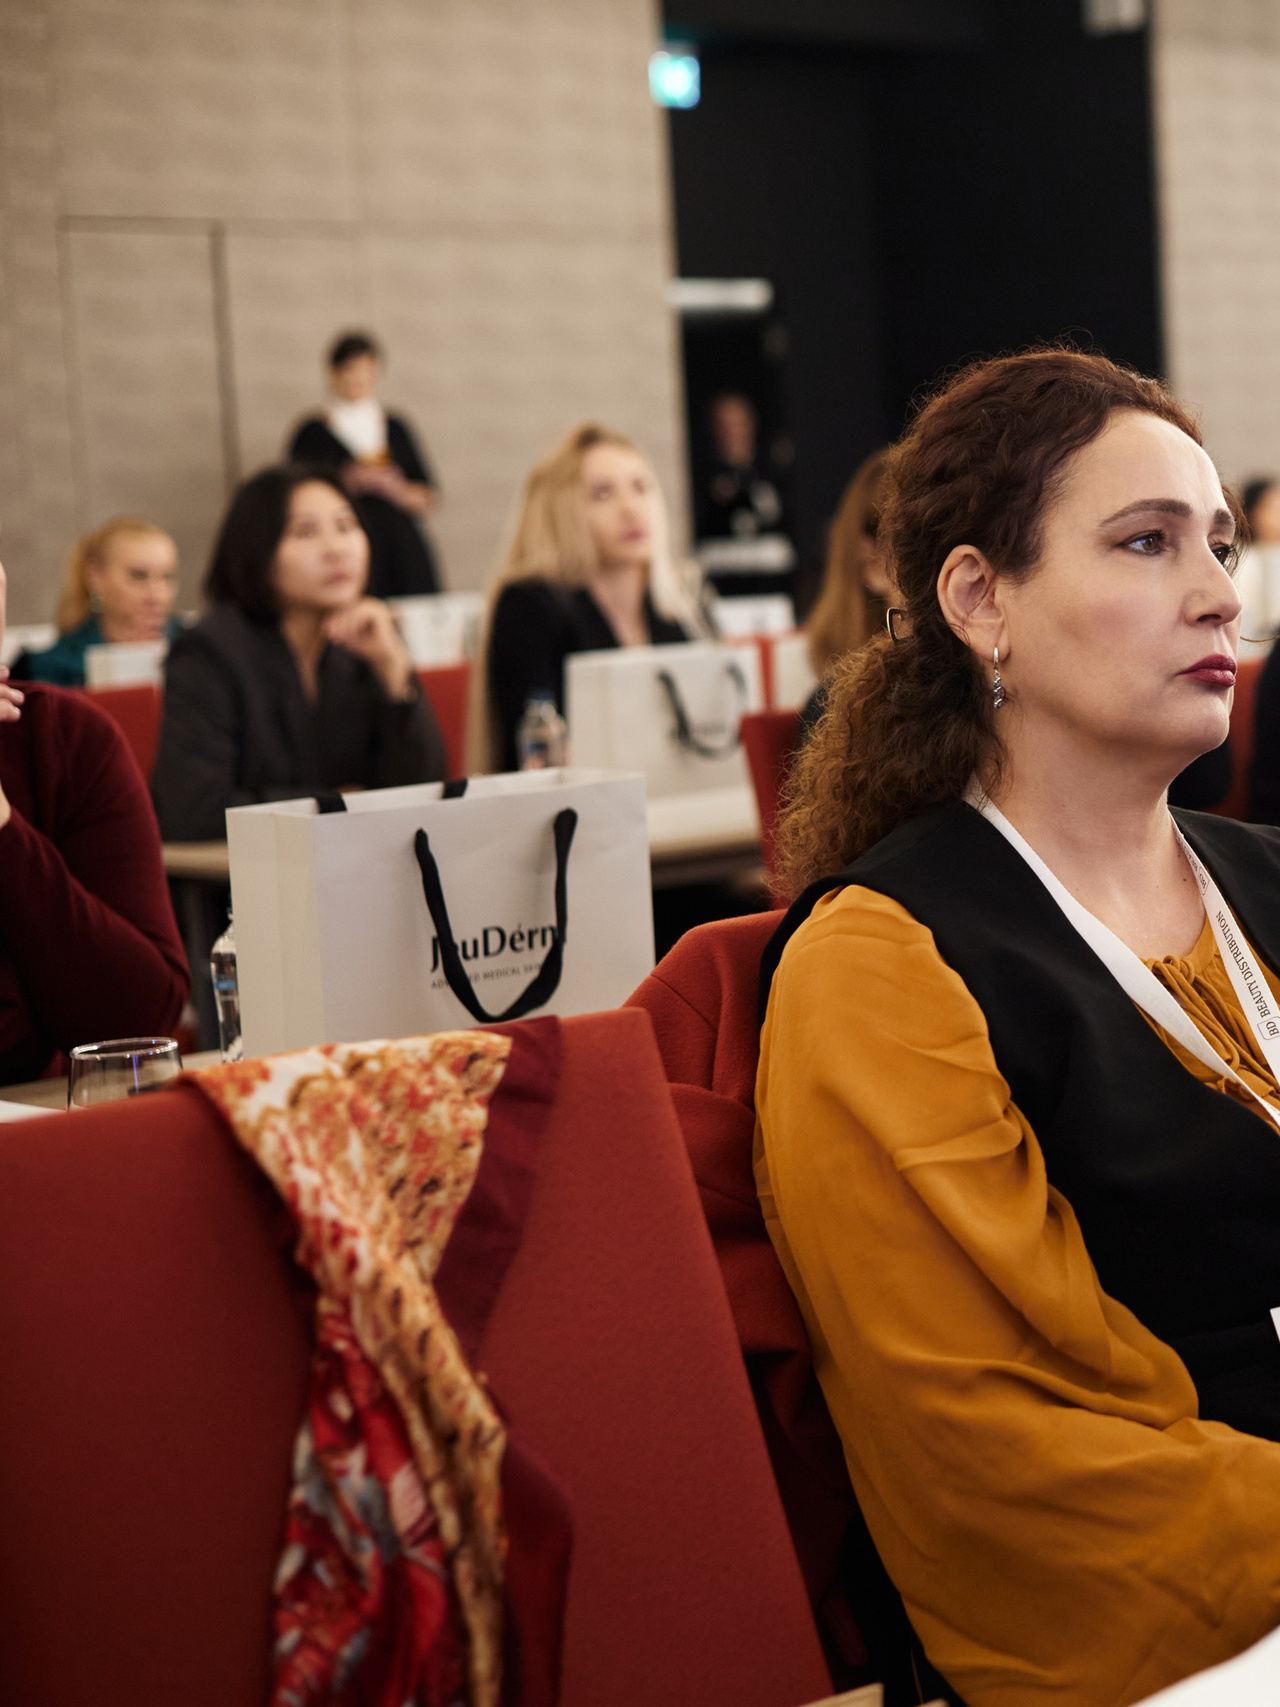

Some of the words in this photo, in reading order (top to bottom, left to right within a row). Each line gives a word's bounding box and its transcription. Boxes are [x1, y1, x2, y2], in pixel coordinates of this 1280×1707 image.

[430, 921, 559, 973] JuDér
[1215, 910, 1254, 981] DISTRIBUTION
[483, 965, 521, 981] MEDICAL
[1246, 979, 1271, 1018] BEAUTY
[1265, 1020, 1280, 1036] BD
